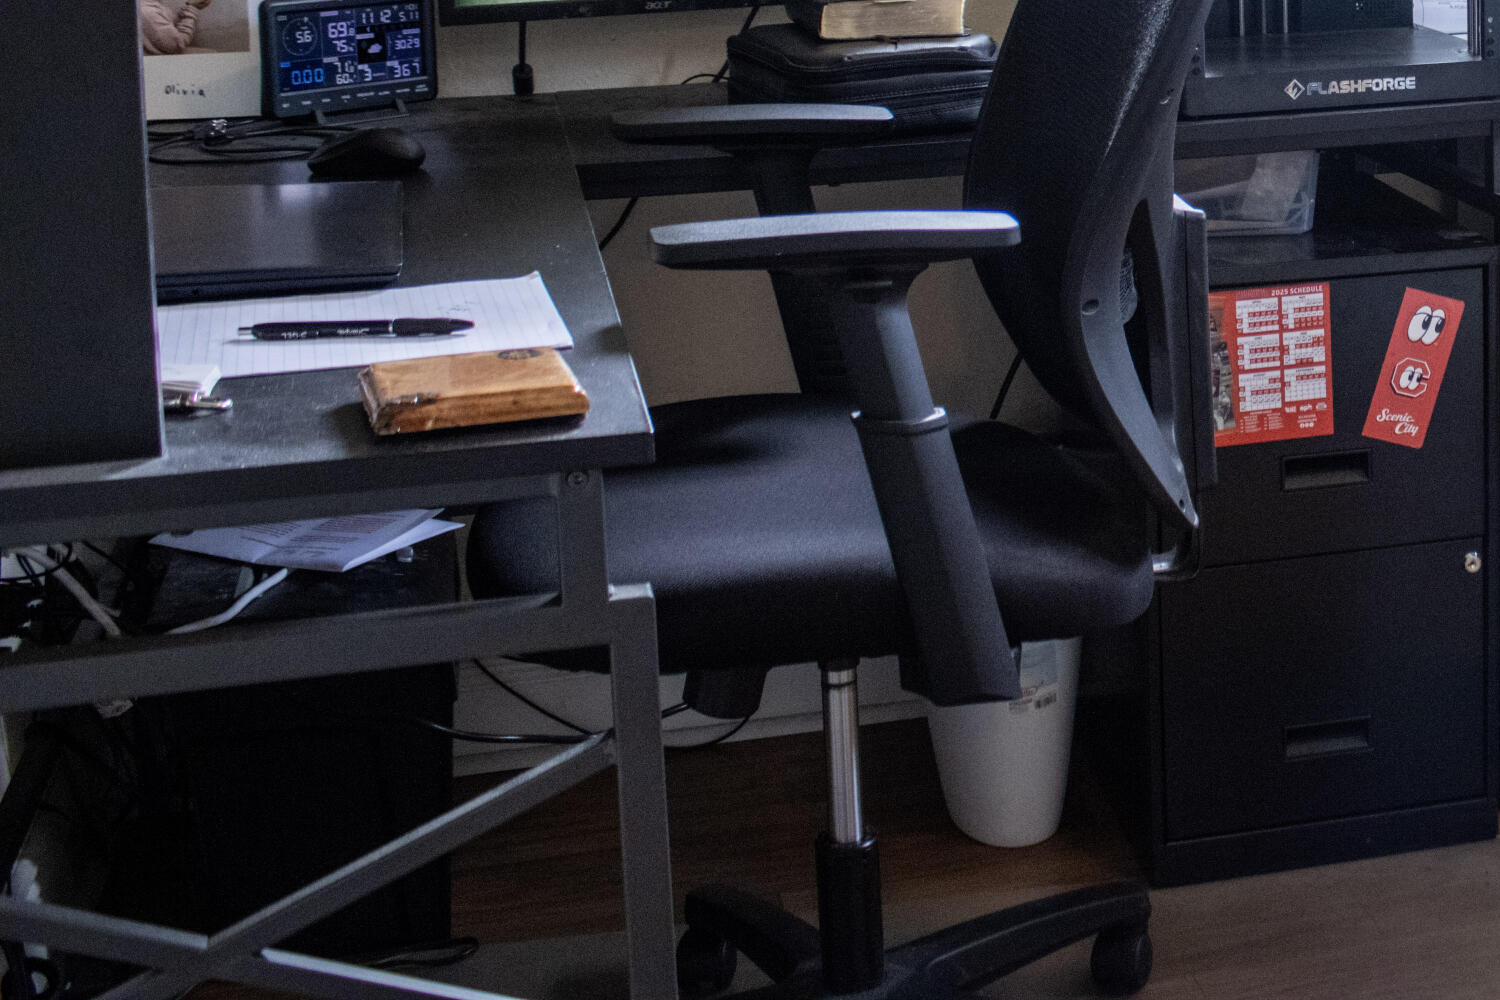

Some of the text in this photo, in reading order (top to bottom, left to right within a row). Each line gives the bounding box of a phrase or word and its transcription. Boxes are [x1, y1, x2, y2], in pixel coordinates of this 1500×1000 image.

[1306, 76, 1417, 96] FLASHFORGE
[1271, 285, 1323, 297] 2025 SCHEDULE
[1376, 408, 1416, 423] Scenic
[1394, 421, 1420, 437] City
